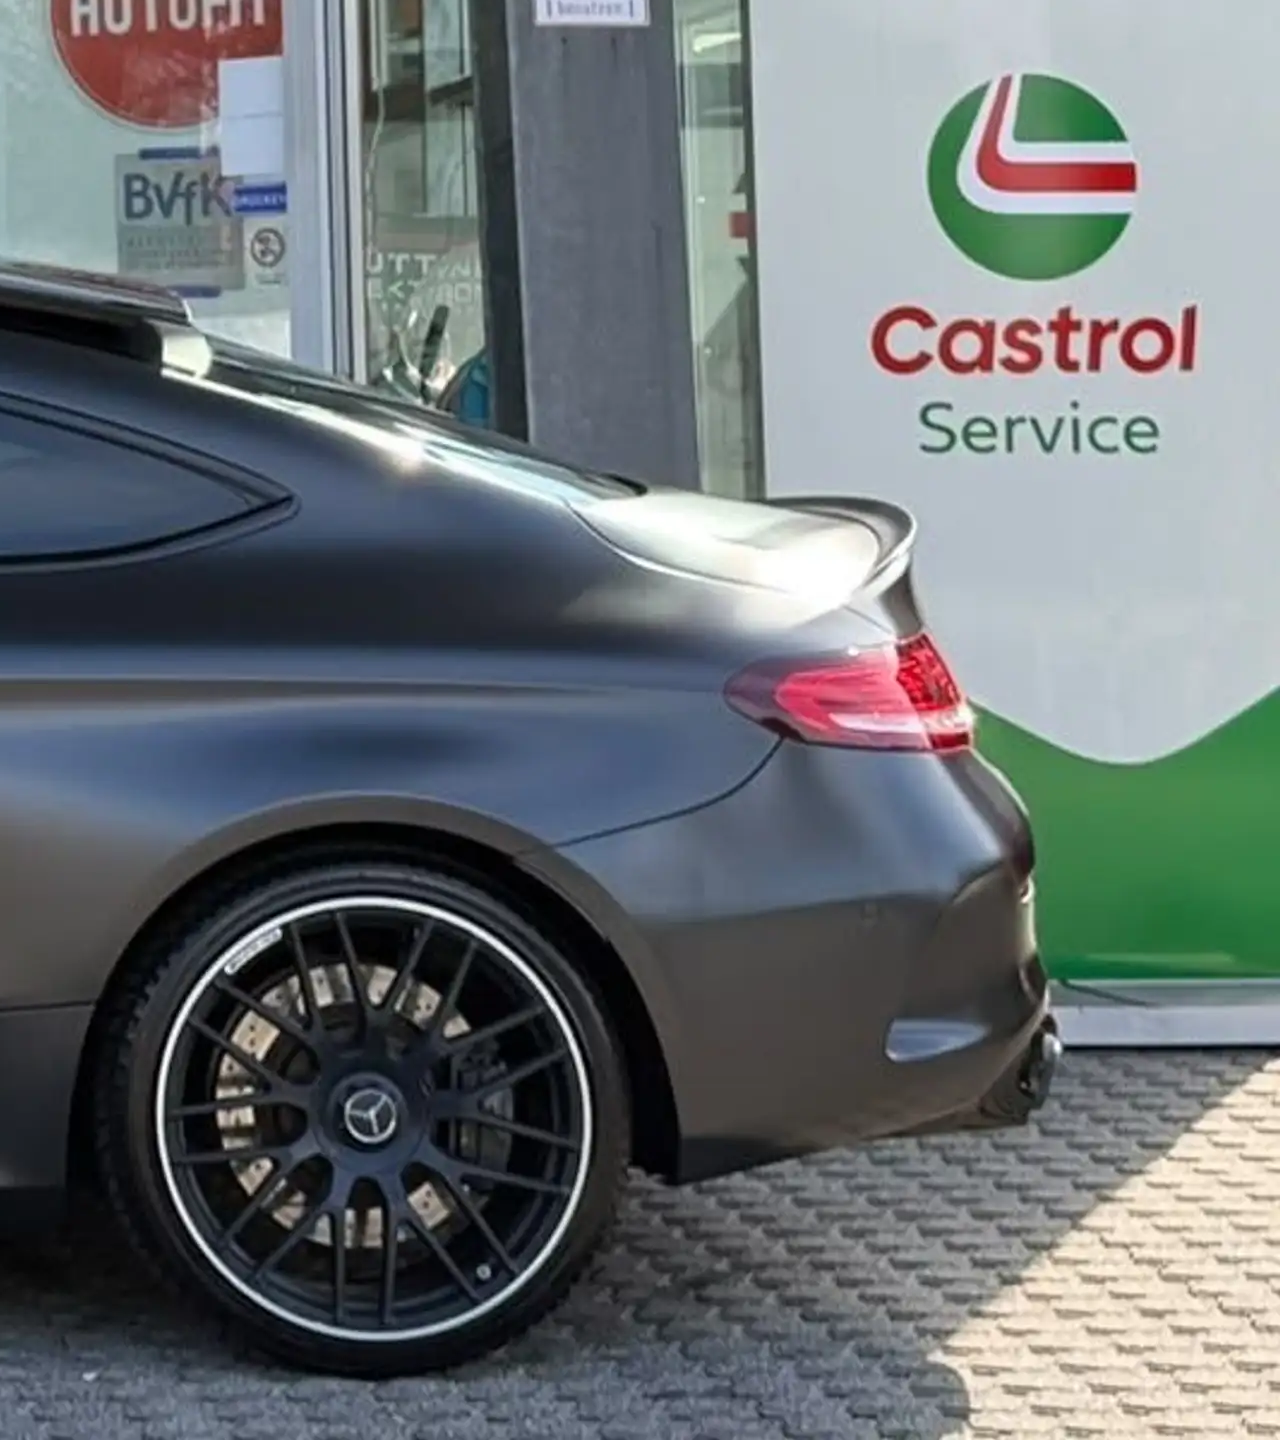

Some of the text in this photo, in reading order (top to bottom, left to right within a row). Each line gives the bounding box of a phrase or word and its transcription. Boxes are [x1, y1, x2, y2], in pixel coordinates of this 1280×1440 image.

[123, 171, 233, 227] BvfK
[870, 304, 1197, 376] Castrol
[919, 400, 1160, 455] Service
